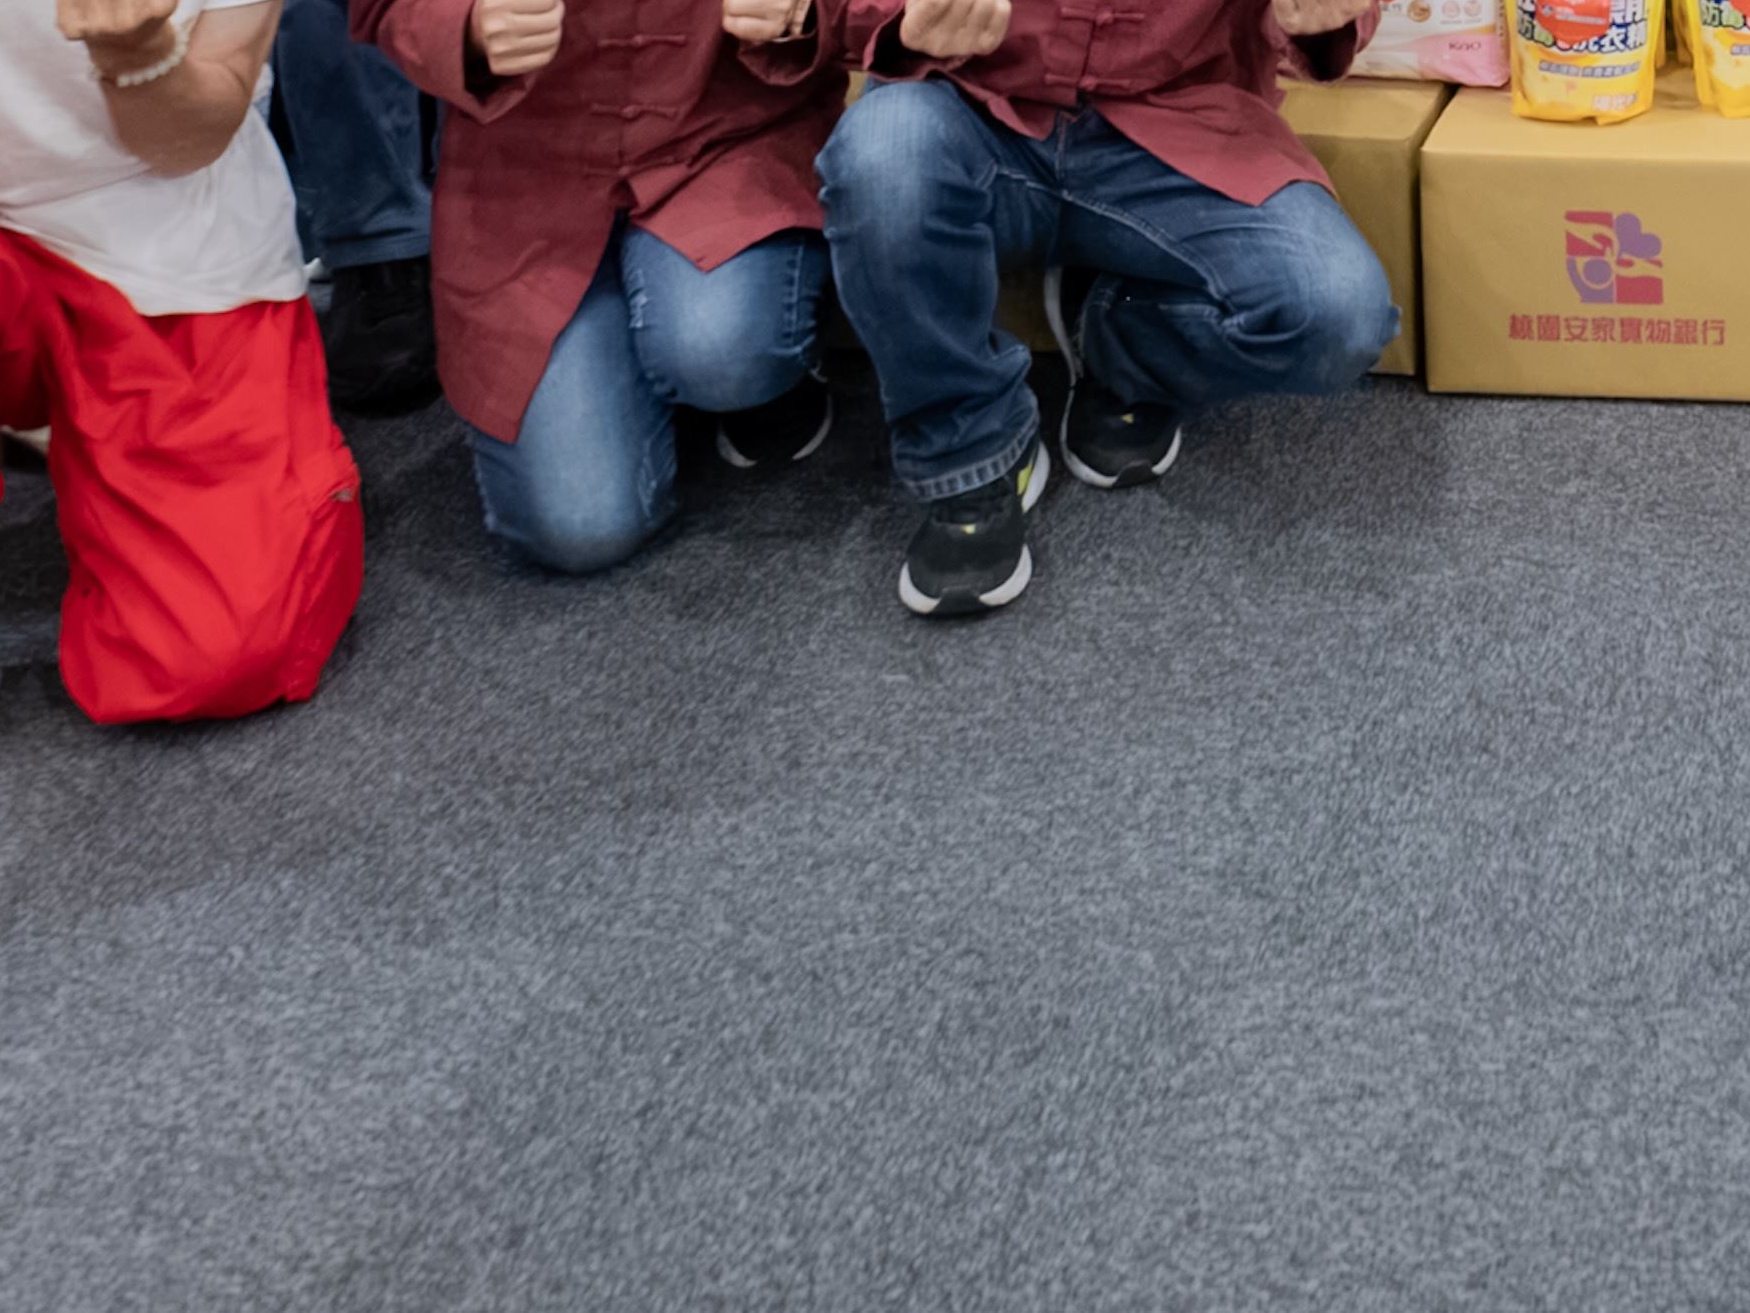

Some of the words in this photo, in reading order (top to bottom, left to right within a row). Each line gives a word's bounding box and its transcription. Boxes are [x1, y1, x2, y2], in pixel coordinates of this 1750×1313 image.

[1508, 313, 1726, 346] 桃園安家實物銀行
